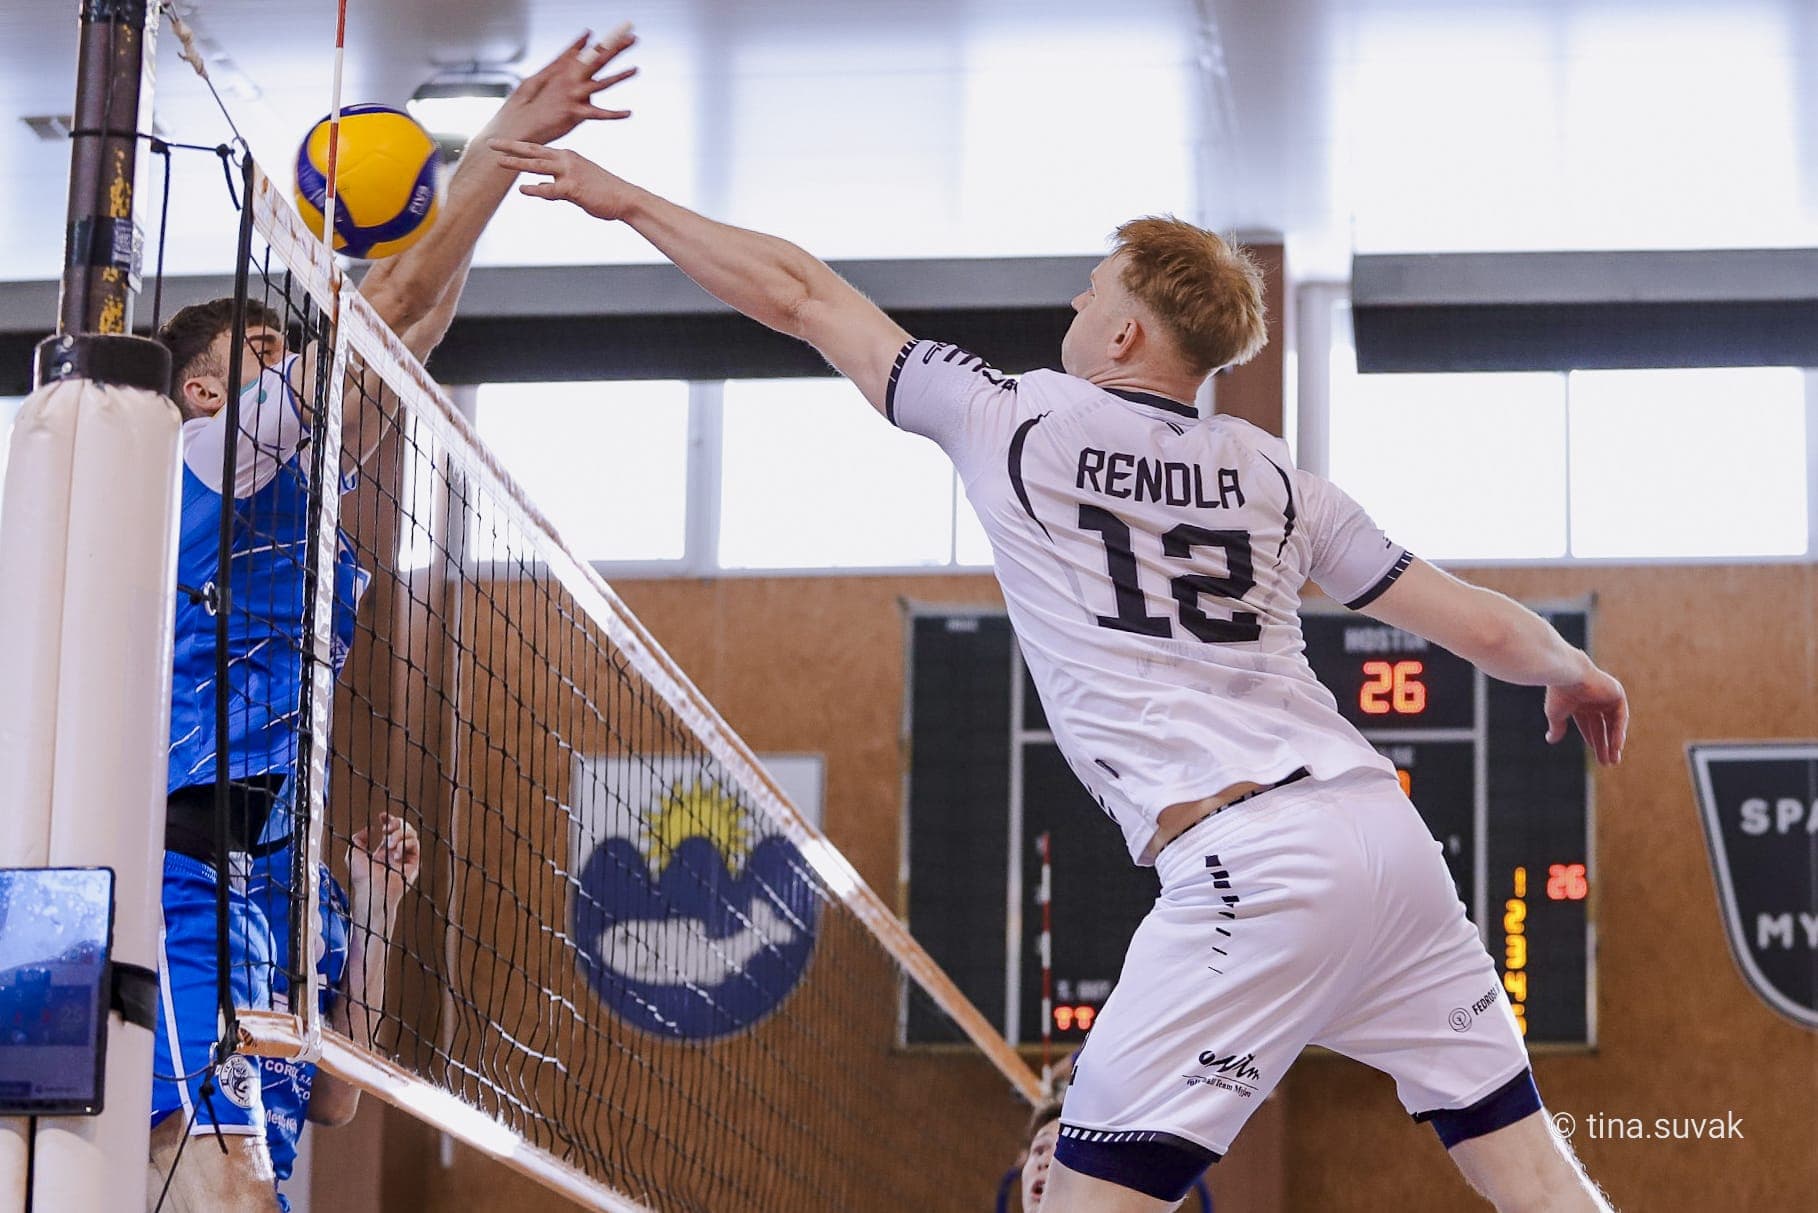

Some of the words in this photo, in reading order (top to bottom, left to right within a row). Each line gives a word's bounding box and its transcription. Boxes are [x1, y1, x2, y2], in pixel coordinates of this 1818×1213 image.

[1078, 503, 1262, 643] 12
[1360, 660, 1426, 714] 26
[1547, 863, 1588, 900] 26
